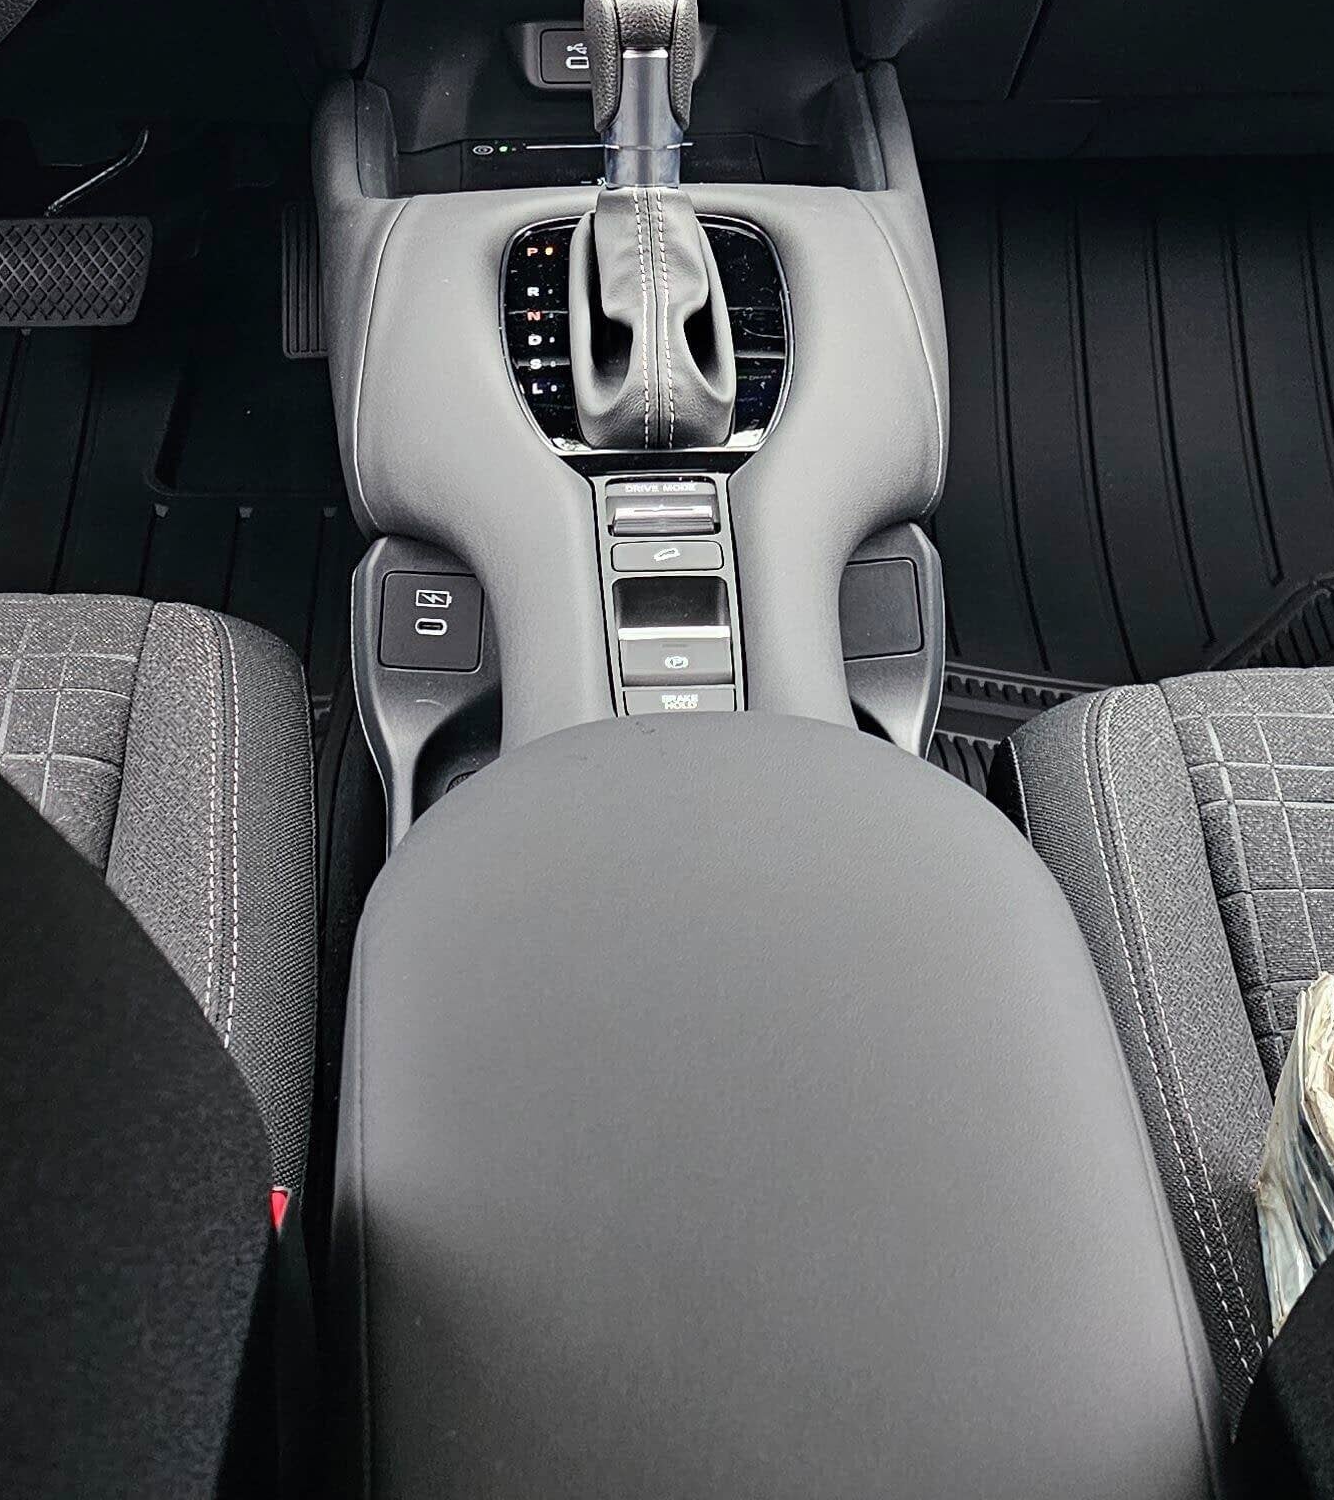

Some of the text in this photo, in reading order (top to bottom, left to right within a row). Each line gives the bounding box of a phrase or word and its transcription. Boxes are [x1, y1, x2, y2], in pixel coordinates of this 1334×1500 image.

[526, 246, 539, 257] P
[526, 286, 540, 297] R
[526, 310, 541, 321] N
[527, 334, 543, 346] D
[529, 358, 543, 370] S
[531, 382, 544, 395] L
[625, 482, 697, 493] DRIVE MODE
[661, 694, 699, 702] BRAKE
[664, 701, 698, 710] HOLD
